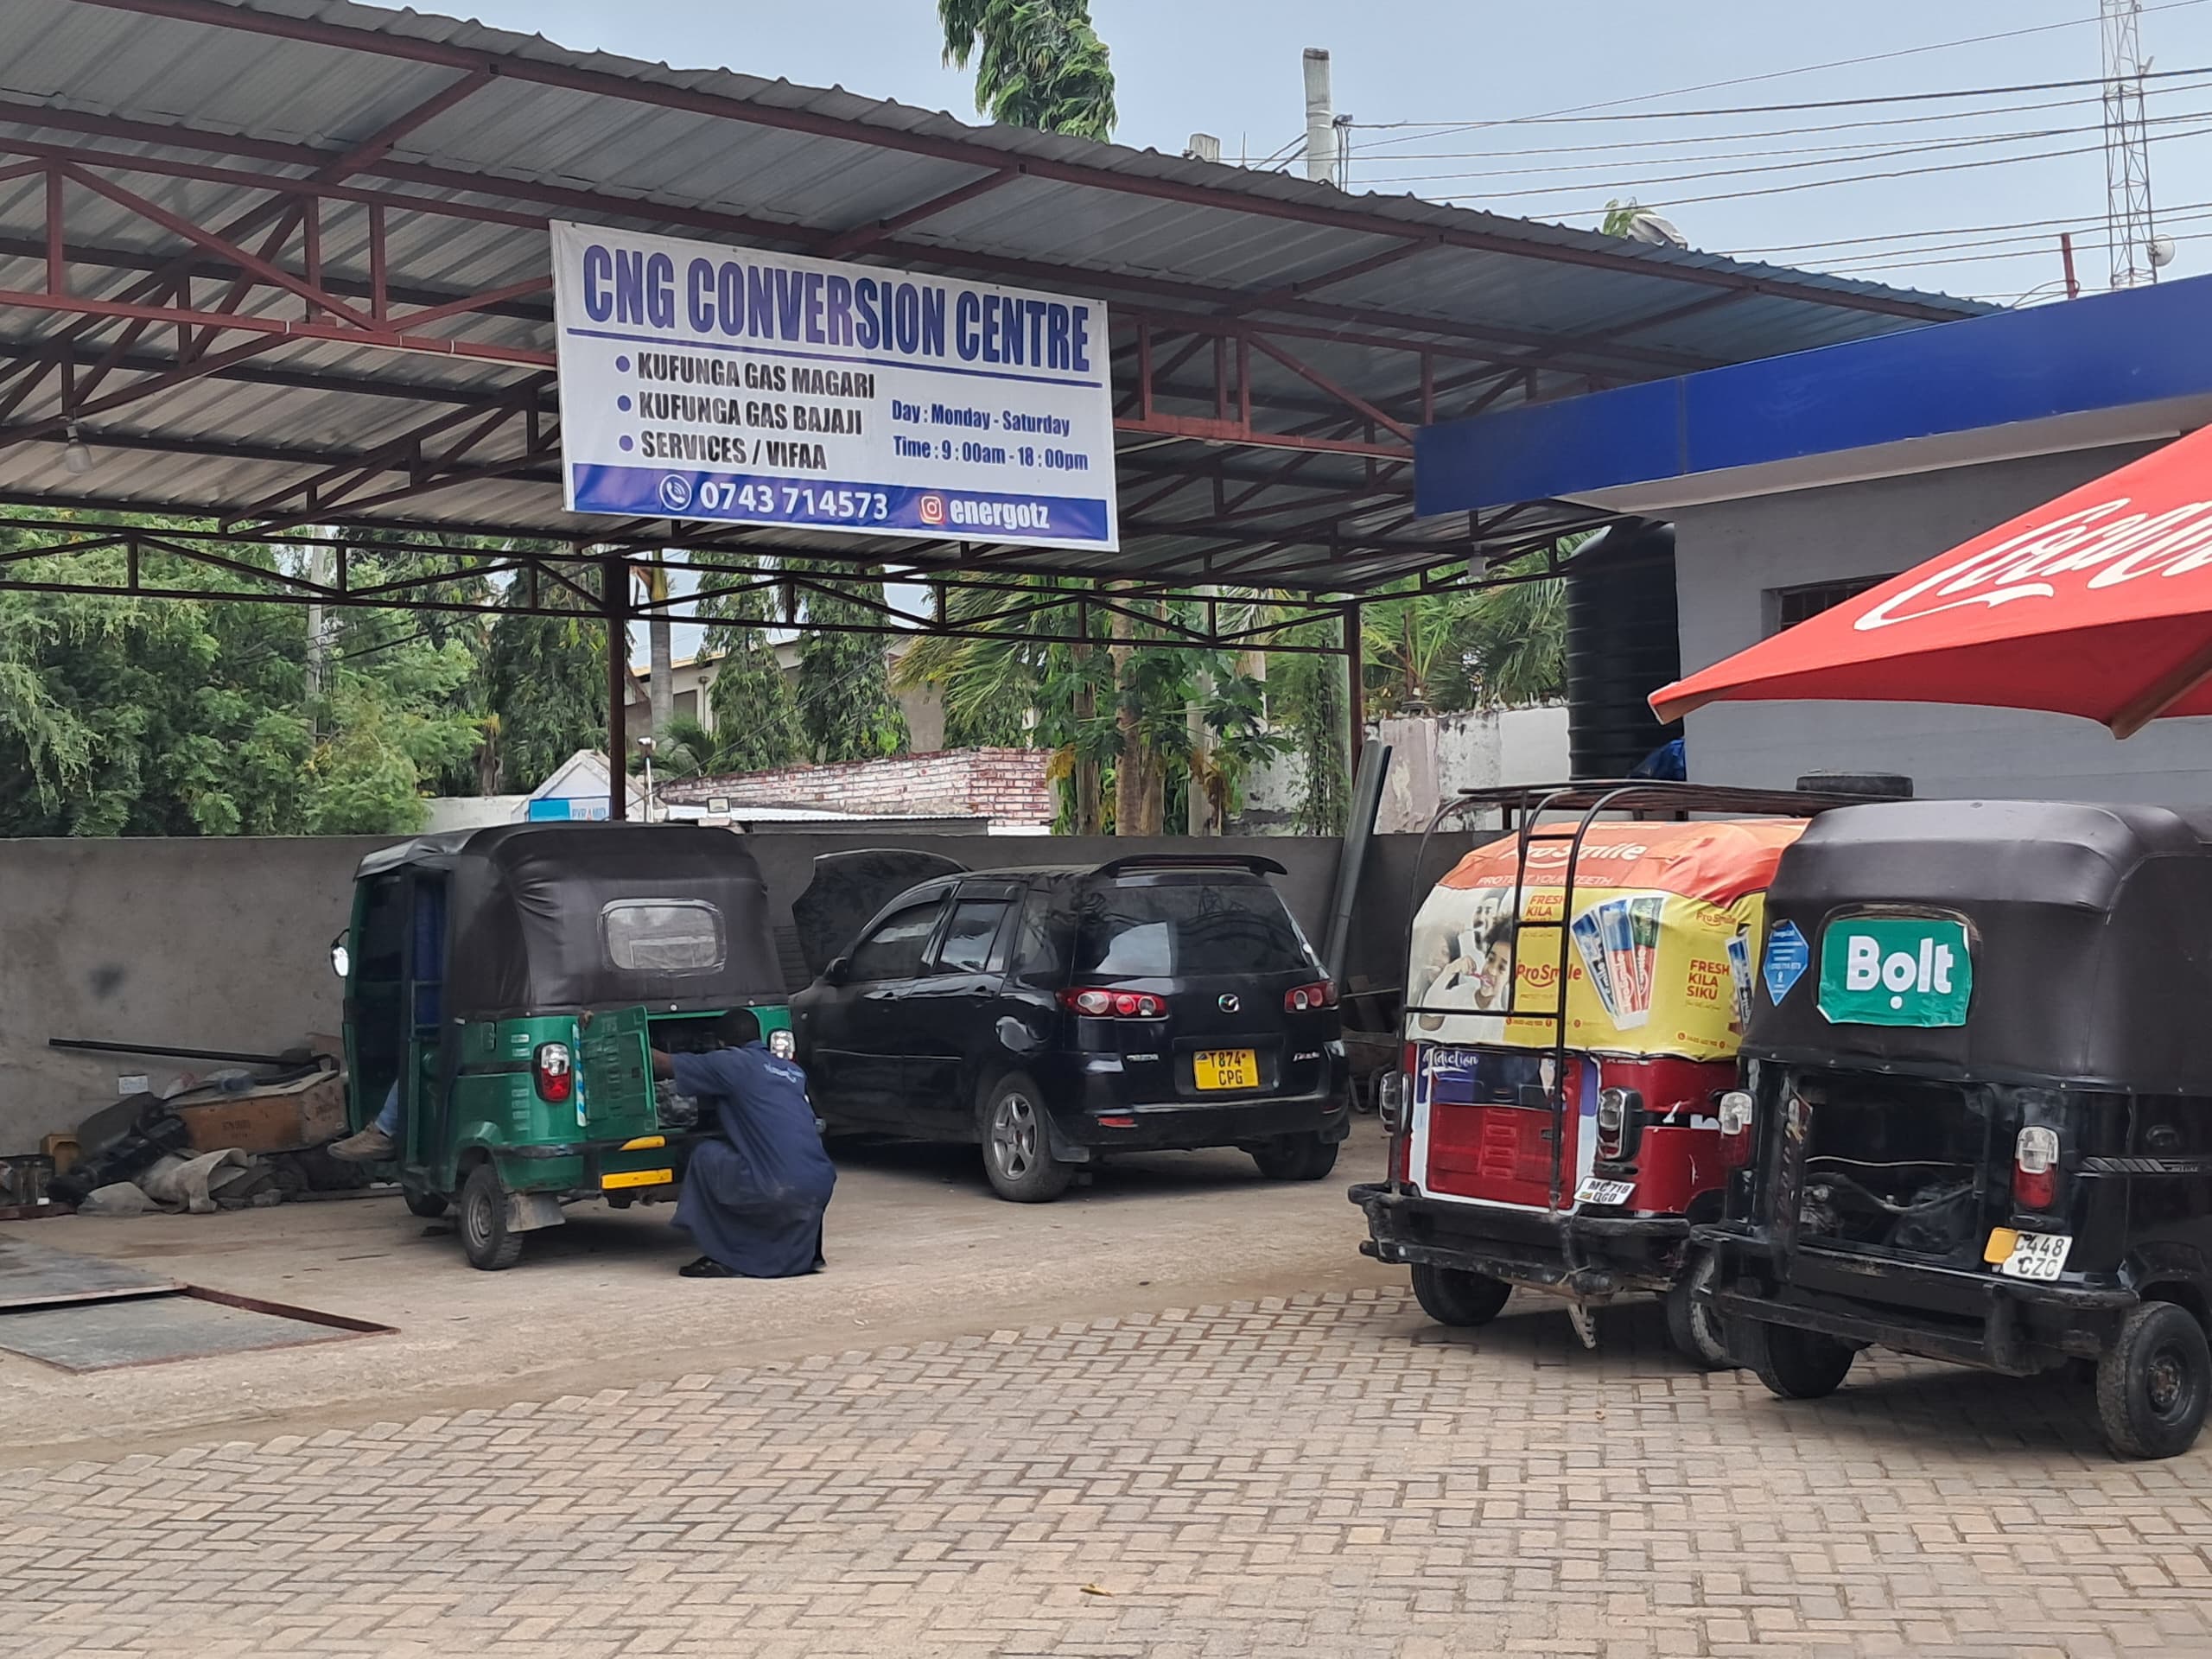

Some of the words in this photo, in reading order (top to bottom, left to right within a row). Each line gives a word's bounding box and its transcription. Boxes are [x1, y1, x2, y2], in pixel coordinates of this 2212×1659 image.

[583, 245, 675, 328] CNG
[688, 257, 944, 358] CONVERSION
[957, 290, 1090, 372] CENTRE
[638, 353, 740, 387] KUFUNGA
[745, 364, 786, 392] GAS
[792, 367, 874, 398] MAGARI
[639, 391, 740, 425] KUFUNGA
[746, 403, 788, 431] GAS
[793, 406, 862, 435] BAJAJI
[931, 404, 990, 431] Monday
[1002, 410, 1071, 438] Saturday
[641, 431, 747, 465] SERVICES
[766, 442, 827, 470] VIFAA
[700, 482, 775, 514] 0743
[782, 486, 888, 520] 714573
[950, 499, 1050, 531] energotz
[1477, 875, 1533, 886] PROTET
[1527, 906, 1552, 916] KILA
[1688, 973, 1719, 988] KILA
[1690, 959, 1730, 976] FRESH
[1847, 935, 1954, 1009] Bolt
[1687, 986, 1718, 1000] SIKU
[1209, 1052, 1242, 1068] T874
[1219, 1070, 1243, 1085] CPG
